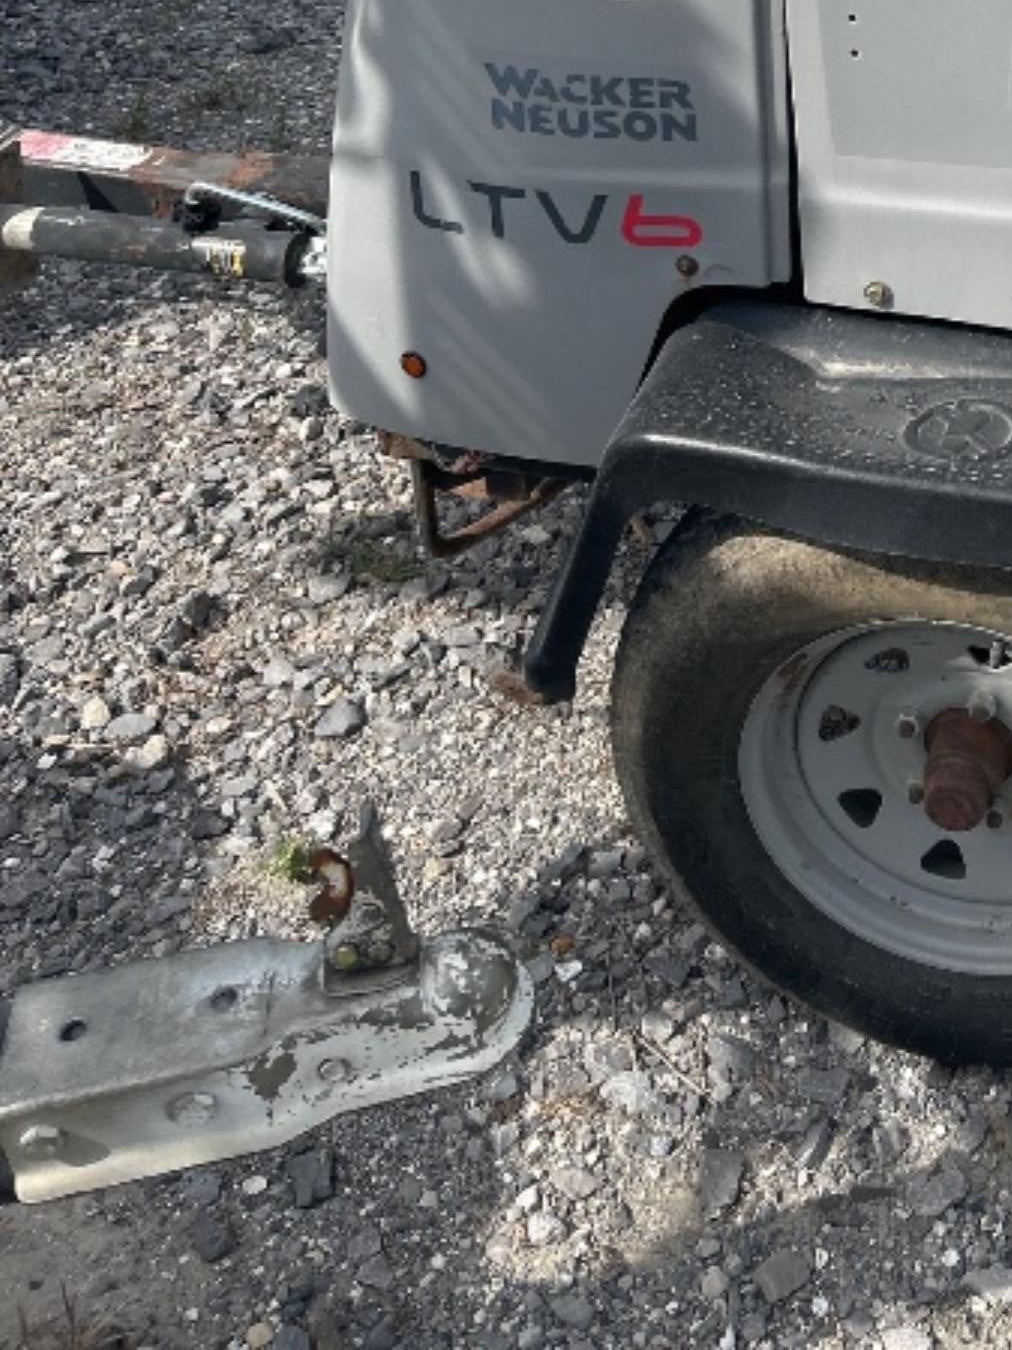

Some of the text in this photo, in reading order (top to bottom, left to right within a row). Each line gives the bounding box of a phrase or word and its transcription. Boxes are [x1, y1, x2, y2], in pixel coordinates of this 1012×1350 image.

[483, 61, 695, 110] WACKER
[490, 97, 698, 143] NEUSON
[409, 170, 703, 248] LTV6
